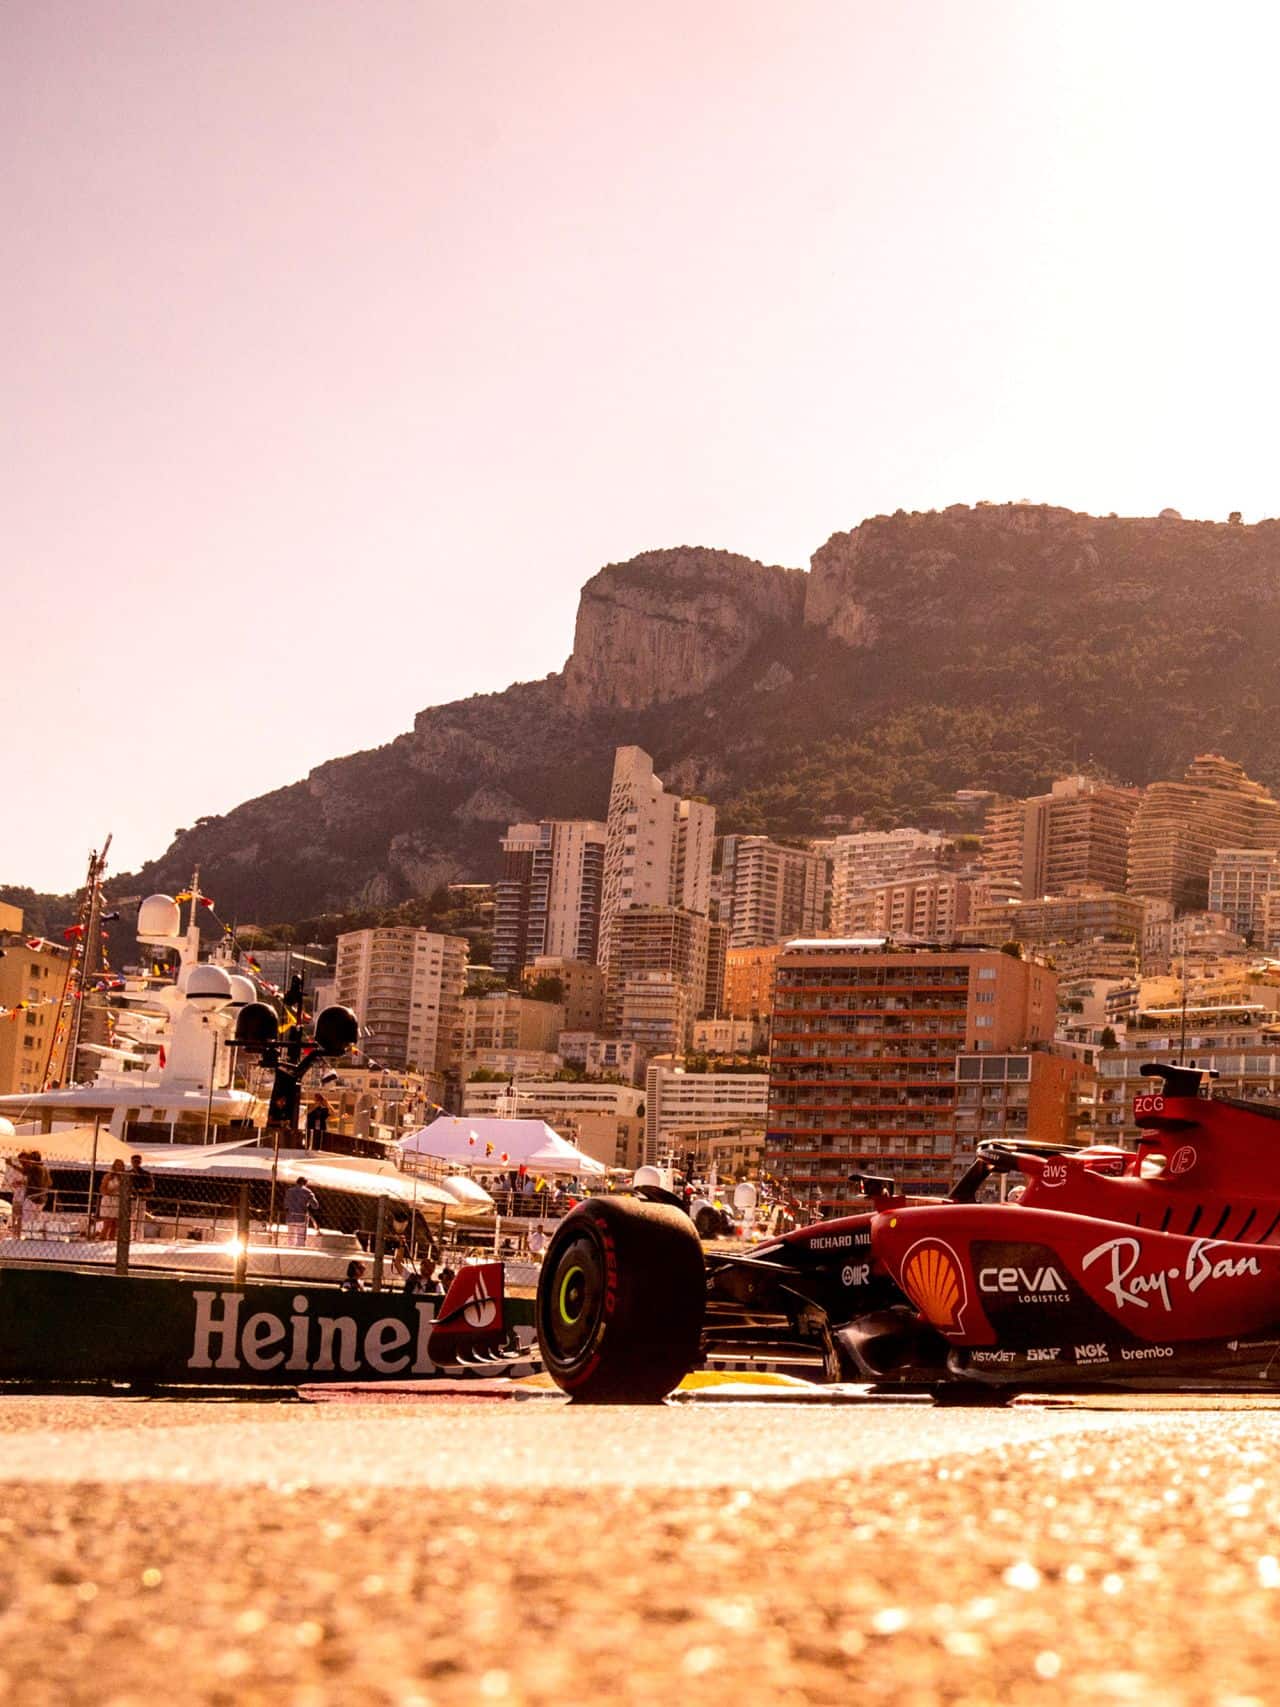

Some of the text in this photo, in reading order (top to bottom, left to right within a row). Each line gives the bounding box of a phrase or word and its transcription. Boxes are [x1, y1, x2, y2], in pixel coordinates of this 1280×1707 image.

[1135, 1096, 1164, 1113] ZCG
[1042, 1164, 1068, 1179] aws
[810, 1234, 852, 1250] RICHARD
[1018, 1294, 1071, 1304] LOGISTICS
[1027, 1347, 1061, 1361] SKF
[1073, 1343, 1108, 1359] NGK
[1121, 1346, 1174, 1361] brembo
